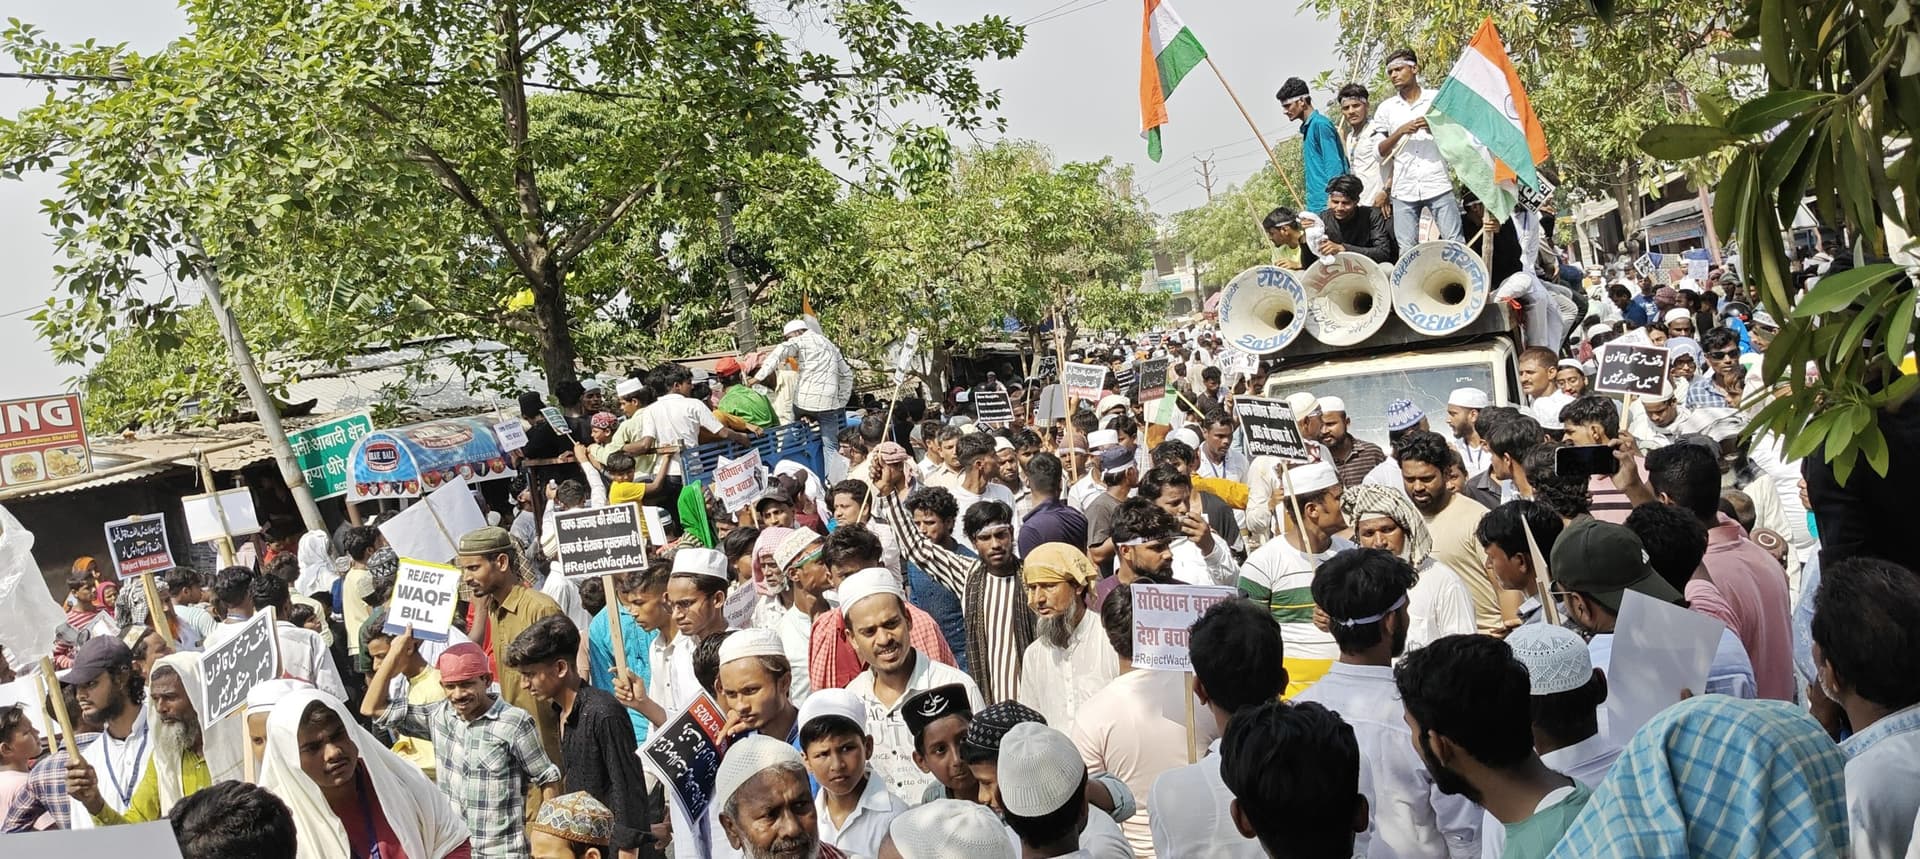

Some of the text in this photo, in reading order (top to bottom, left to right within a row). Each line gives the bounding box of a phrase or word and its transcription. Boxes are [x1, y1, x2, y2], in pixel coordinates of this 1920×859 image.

[312, 425, 347, 451] आबादी
[347, 421, 367, 440] क्षेत्र
[564, 553, 643, 574] #RejectWaqfAct
[407, 568, 444, 585] REJECT
[398, 584, 451, 606] WAQF
[1136, 586, 1189, 612] संविधान
[401, 606, 433, 623] BILL
[1136, 621, 1160, 646] देश
[694, 704, 713, 725] 2025
